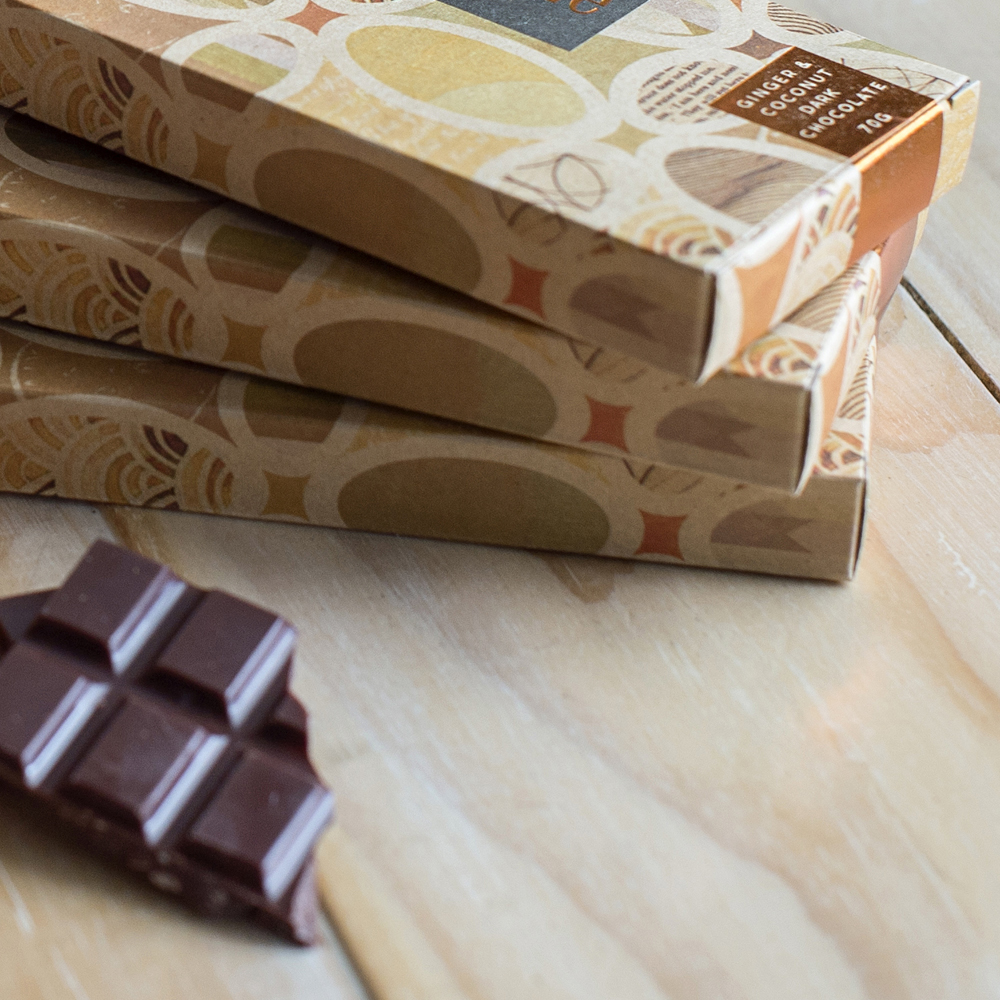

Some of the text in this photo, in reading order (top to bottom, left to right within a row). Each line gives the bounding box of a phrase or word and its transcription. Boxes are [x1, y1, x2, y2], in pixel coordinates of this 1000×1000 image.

[735, 68, 798, 110] GINGER
[794, 59, 813, 70] &
[759, 67, 834, 117] COCONUT
[797, 87, 842, 116] DARK
[799, 81, 889, 140] CHOCOLATE
[856, 111, 893, 135] 70G
